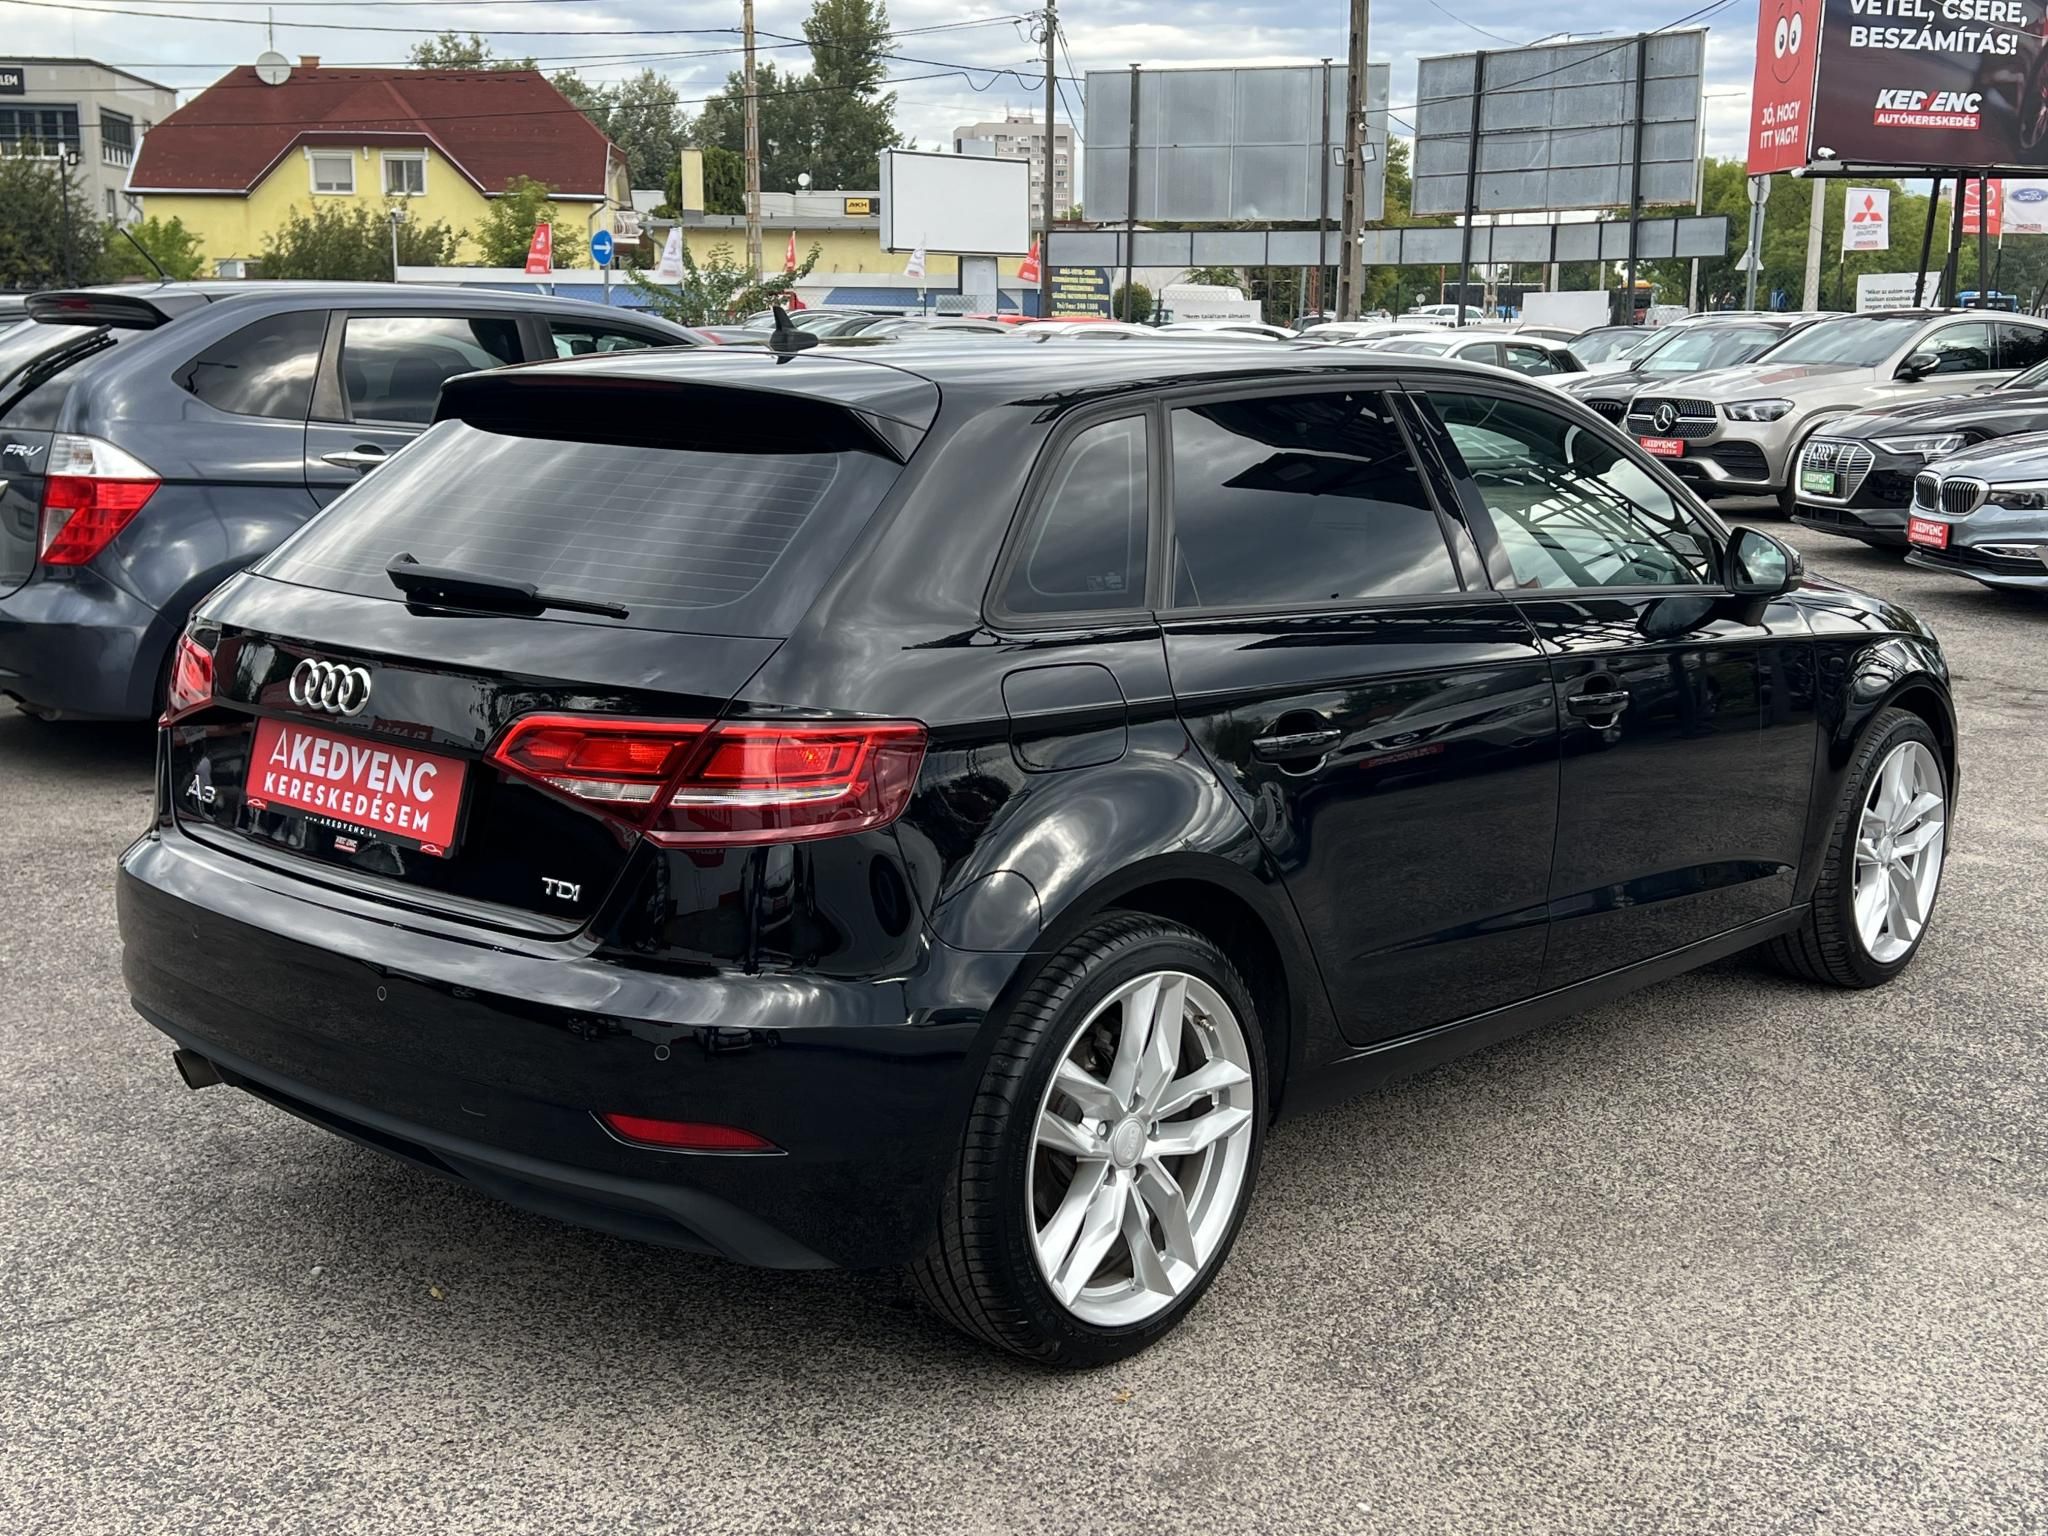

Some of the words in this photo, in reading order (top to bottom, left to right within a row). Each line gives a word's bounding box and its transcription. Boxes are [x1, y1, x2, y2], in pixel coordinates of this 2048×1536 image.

[1942, 0, 2028, 28] CSERE,
[1850, 24, 2019, 55] BESZÁMÍTÁS!
[1762, 101, 1775, 127] JÓ,
[1776, 100, 1801, 123] HOGY
[1877, 113, 1977, 127] AUTÓKERESKEDÉS
[1760, 130, 1774, 149] ITT
[1774, 125, 1799, 146] VAGY!
[3, 444, 44, 457] FR-V
[269, 728, 438, 803] AKEDVENC
[186, 774, 216, 803] A3
[264, 771, 429, 833] KERESKEDÉSEM
[541, 876, 581, 902] TDI
